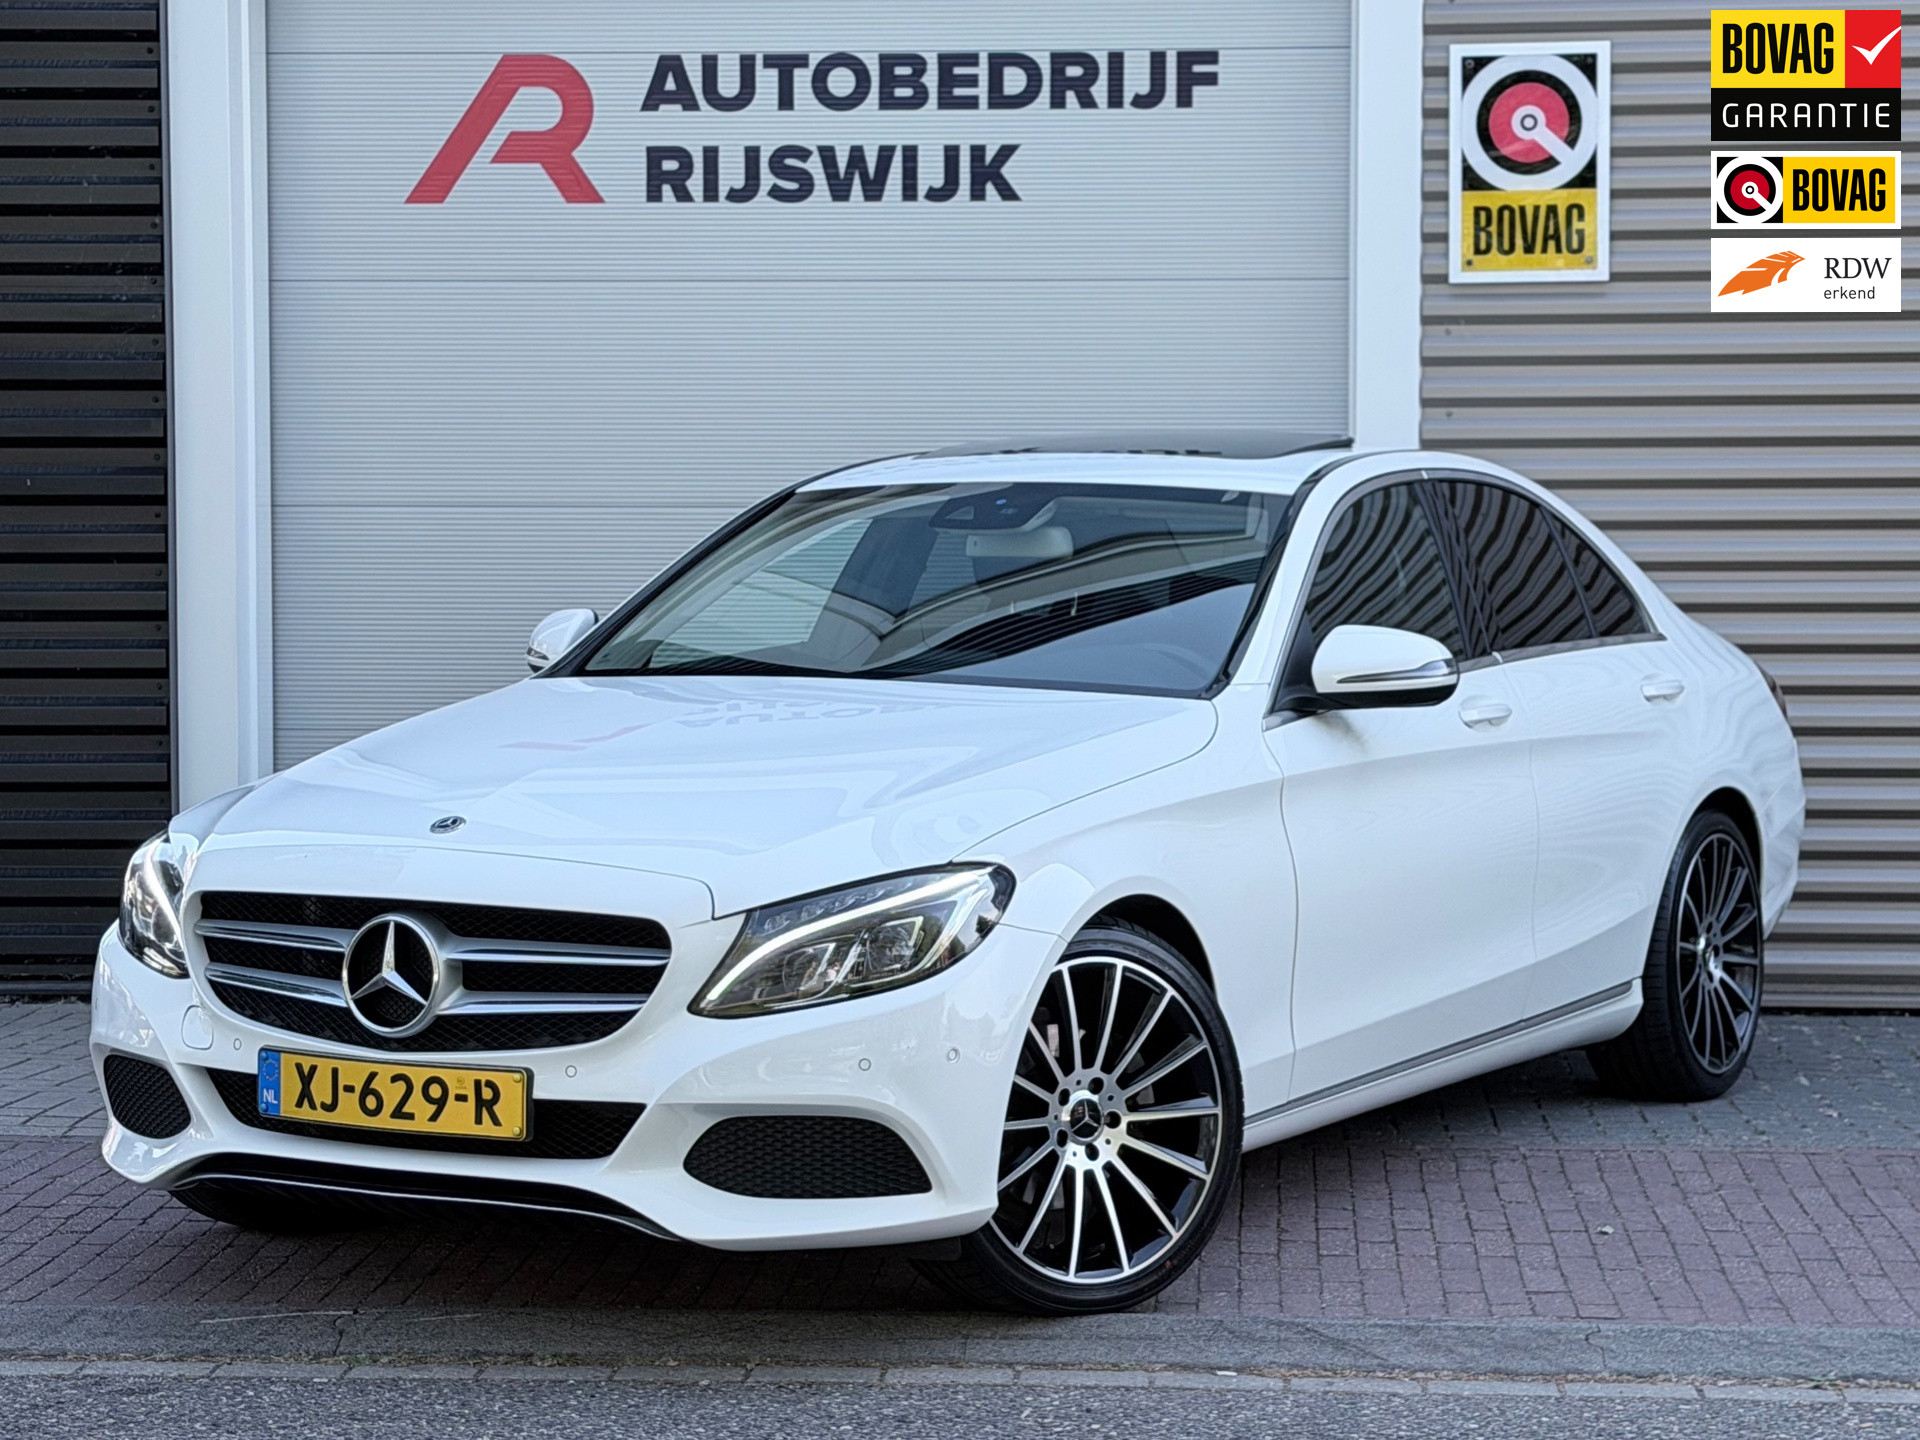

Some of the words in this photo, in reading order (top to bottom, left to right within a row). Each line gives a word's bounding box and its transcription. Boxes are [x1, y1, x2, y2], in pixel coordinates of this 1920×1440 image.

[640, 50, 1220, 112] AUTOBEDRIJF
[645, 144, 1022, 204] RIJSWIJK
[1473, 203, 1586, 256] BOVAG
[263, 1088, 278, 1104] NL
[294, 1062, 503, 1128] XJ-629-R
